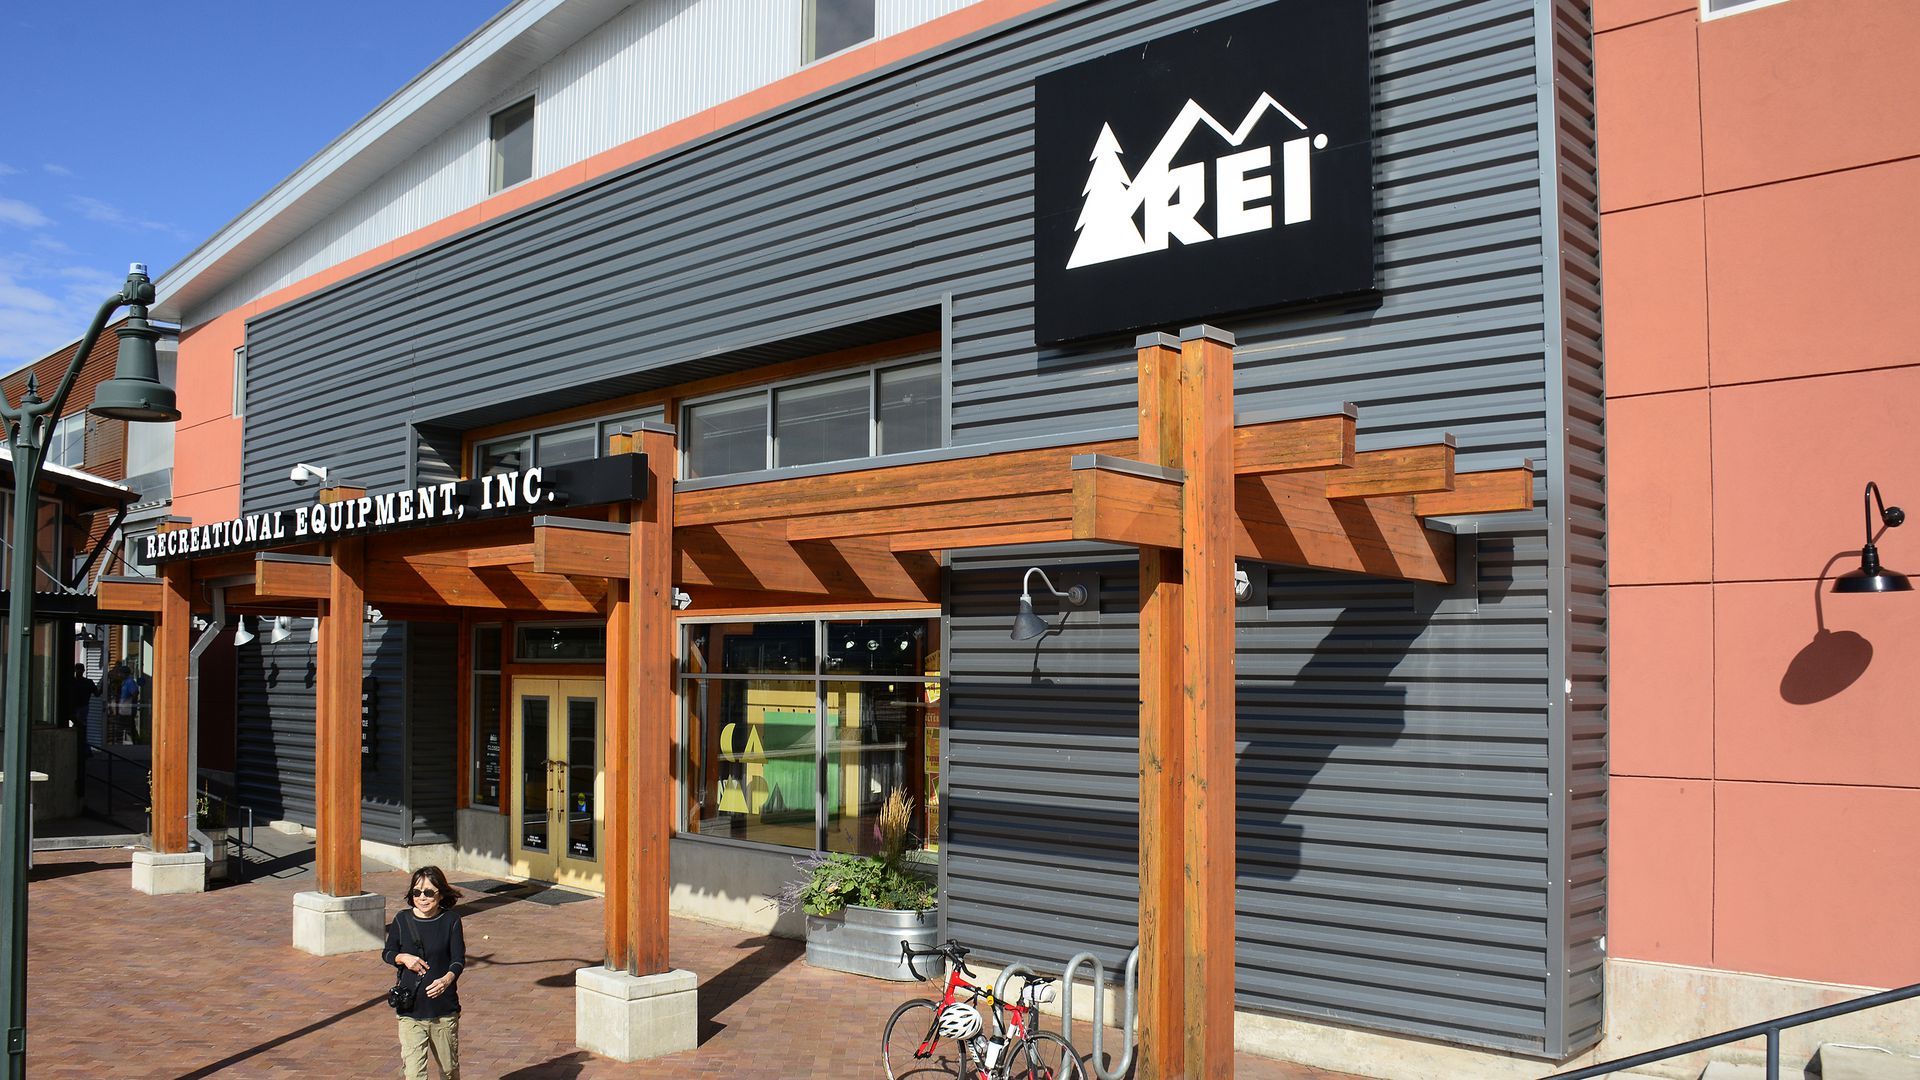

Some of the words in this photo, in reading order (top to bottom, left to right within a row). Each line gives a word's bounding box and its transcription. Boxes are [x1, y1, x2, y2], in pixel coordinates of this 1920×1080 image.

[1144, 136, 1311, 249] REI
[146, 511, 285, 559] RECREATIONAL
[295, 482, 464, 535] EQUIPMENT,
[481, 467, 555, 511] INC.
